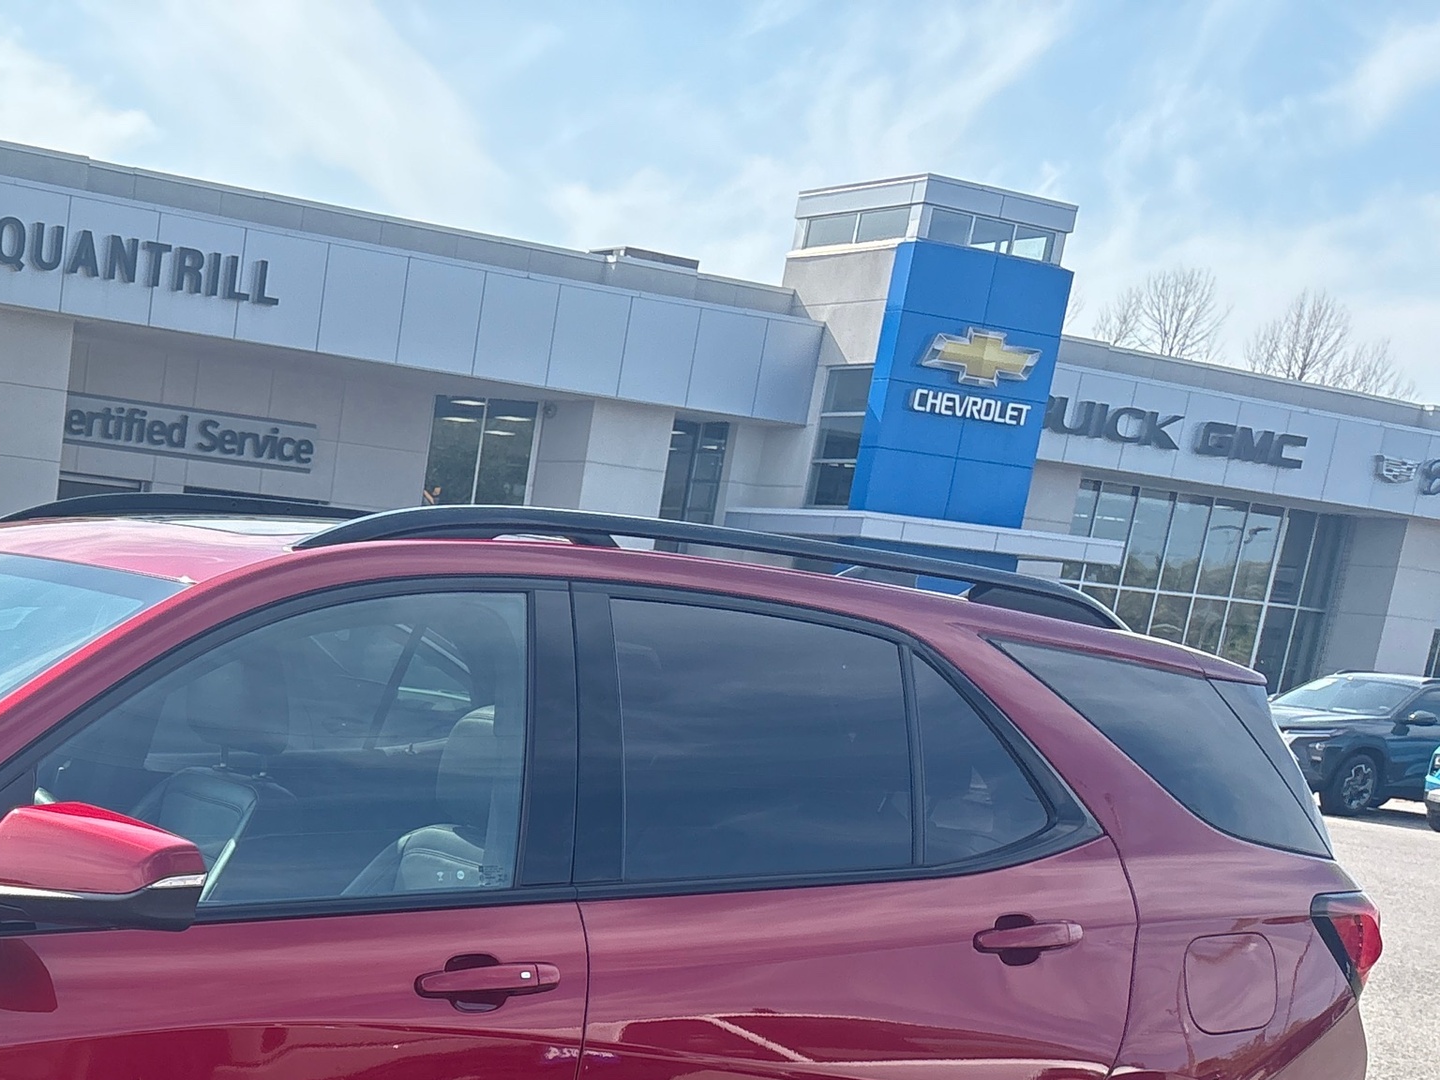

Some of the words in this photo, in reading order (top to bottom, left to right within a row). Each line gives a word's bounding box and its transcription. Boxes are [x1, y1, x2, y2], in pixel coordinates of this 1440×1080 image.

[912, 388, 1032, 426] CHEVROLET
[65, 407, 188, 449] ertified
[195, 419, 314, 464] Service
[1193, 421, 1308, 469] GMC
